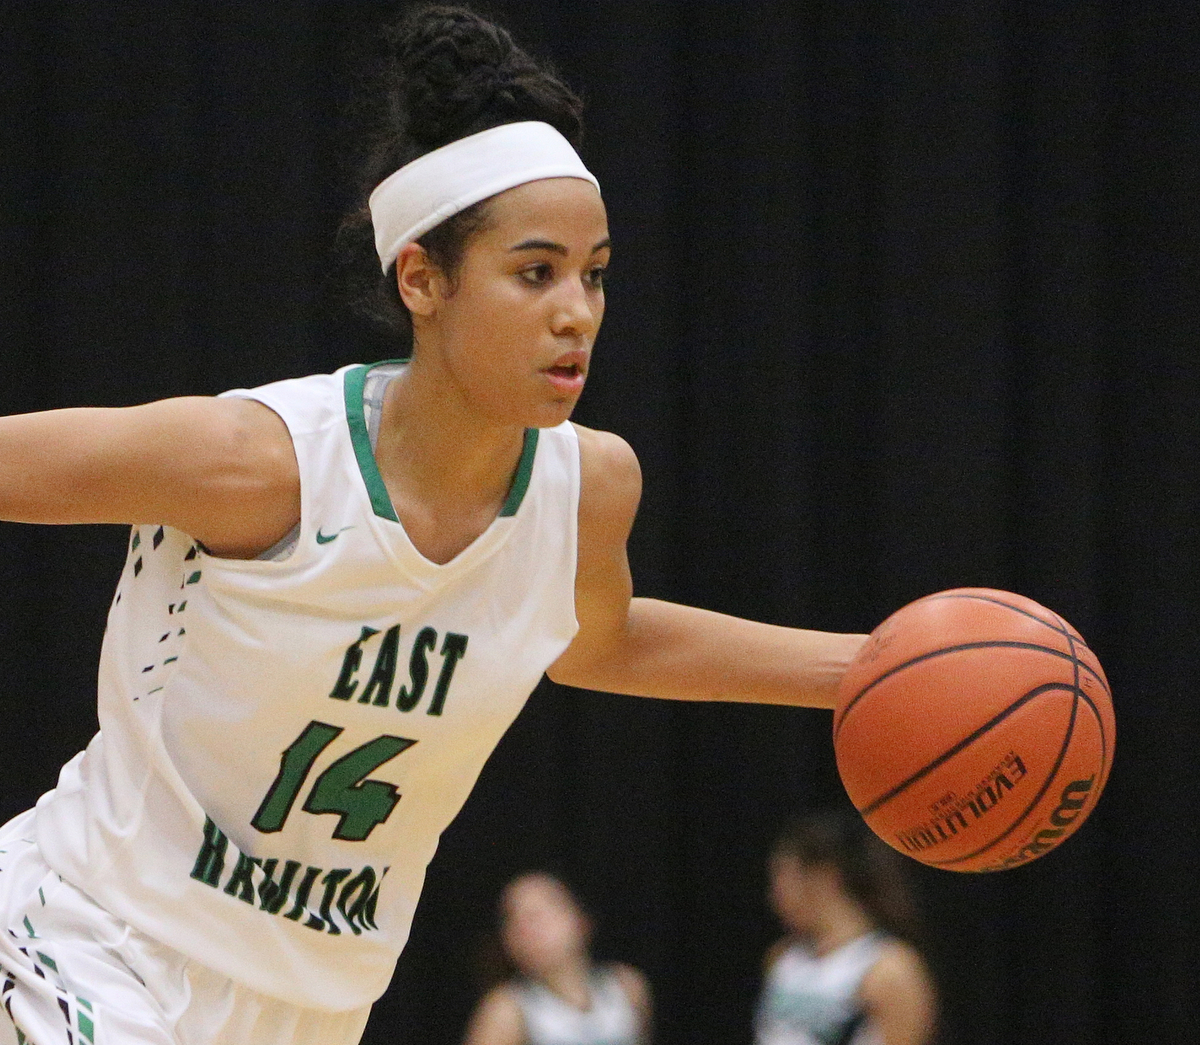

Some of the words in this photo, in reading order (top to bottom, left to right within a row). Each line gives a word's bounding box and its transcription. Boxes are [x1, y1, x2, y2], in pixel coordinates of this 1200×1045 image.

[329, 624, 469, 716] EAST
[250, 720, 419, 841] 14
[901, 756, 1028, 852] EVOLUTION
